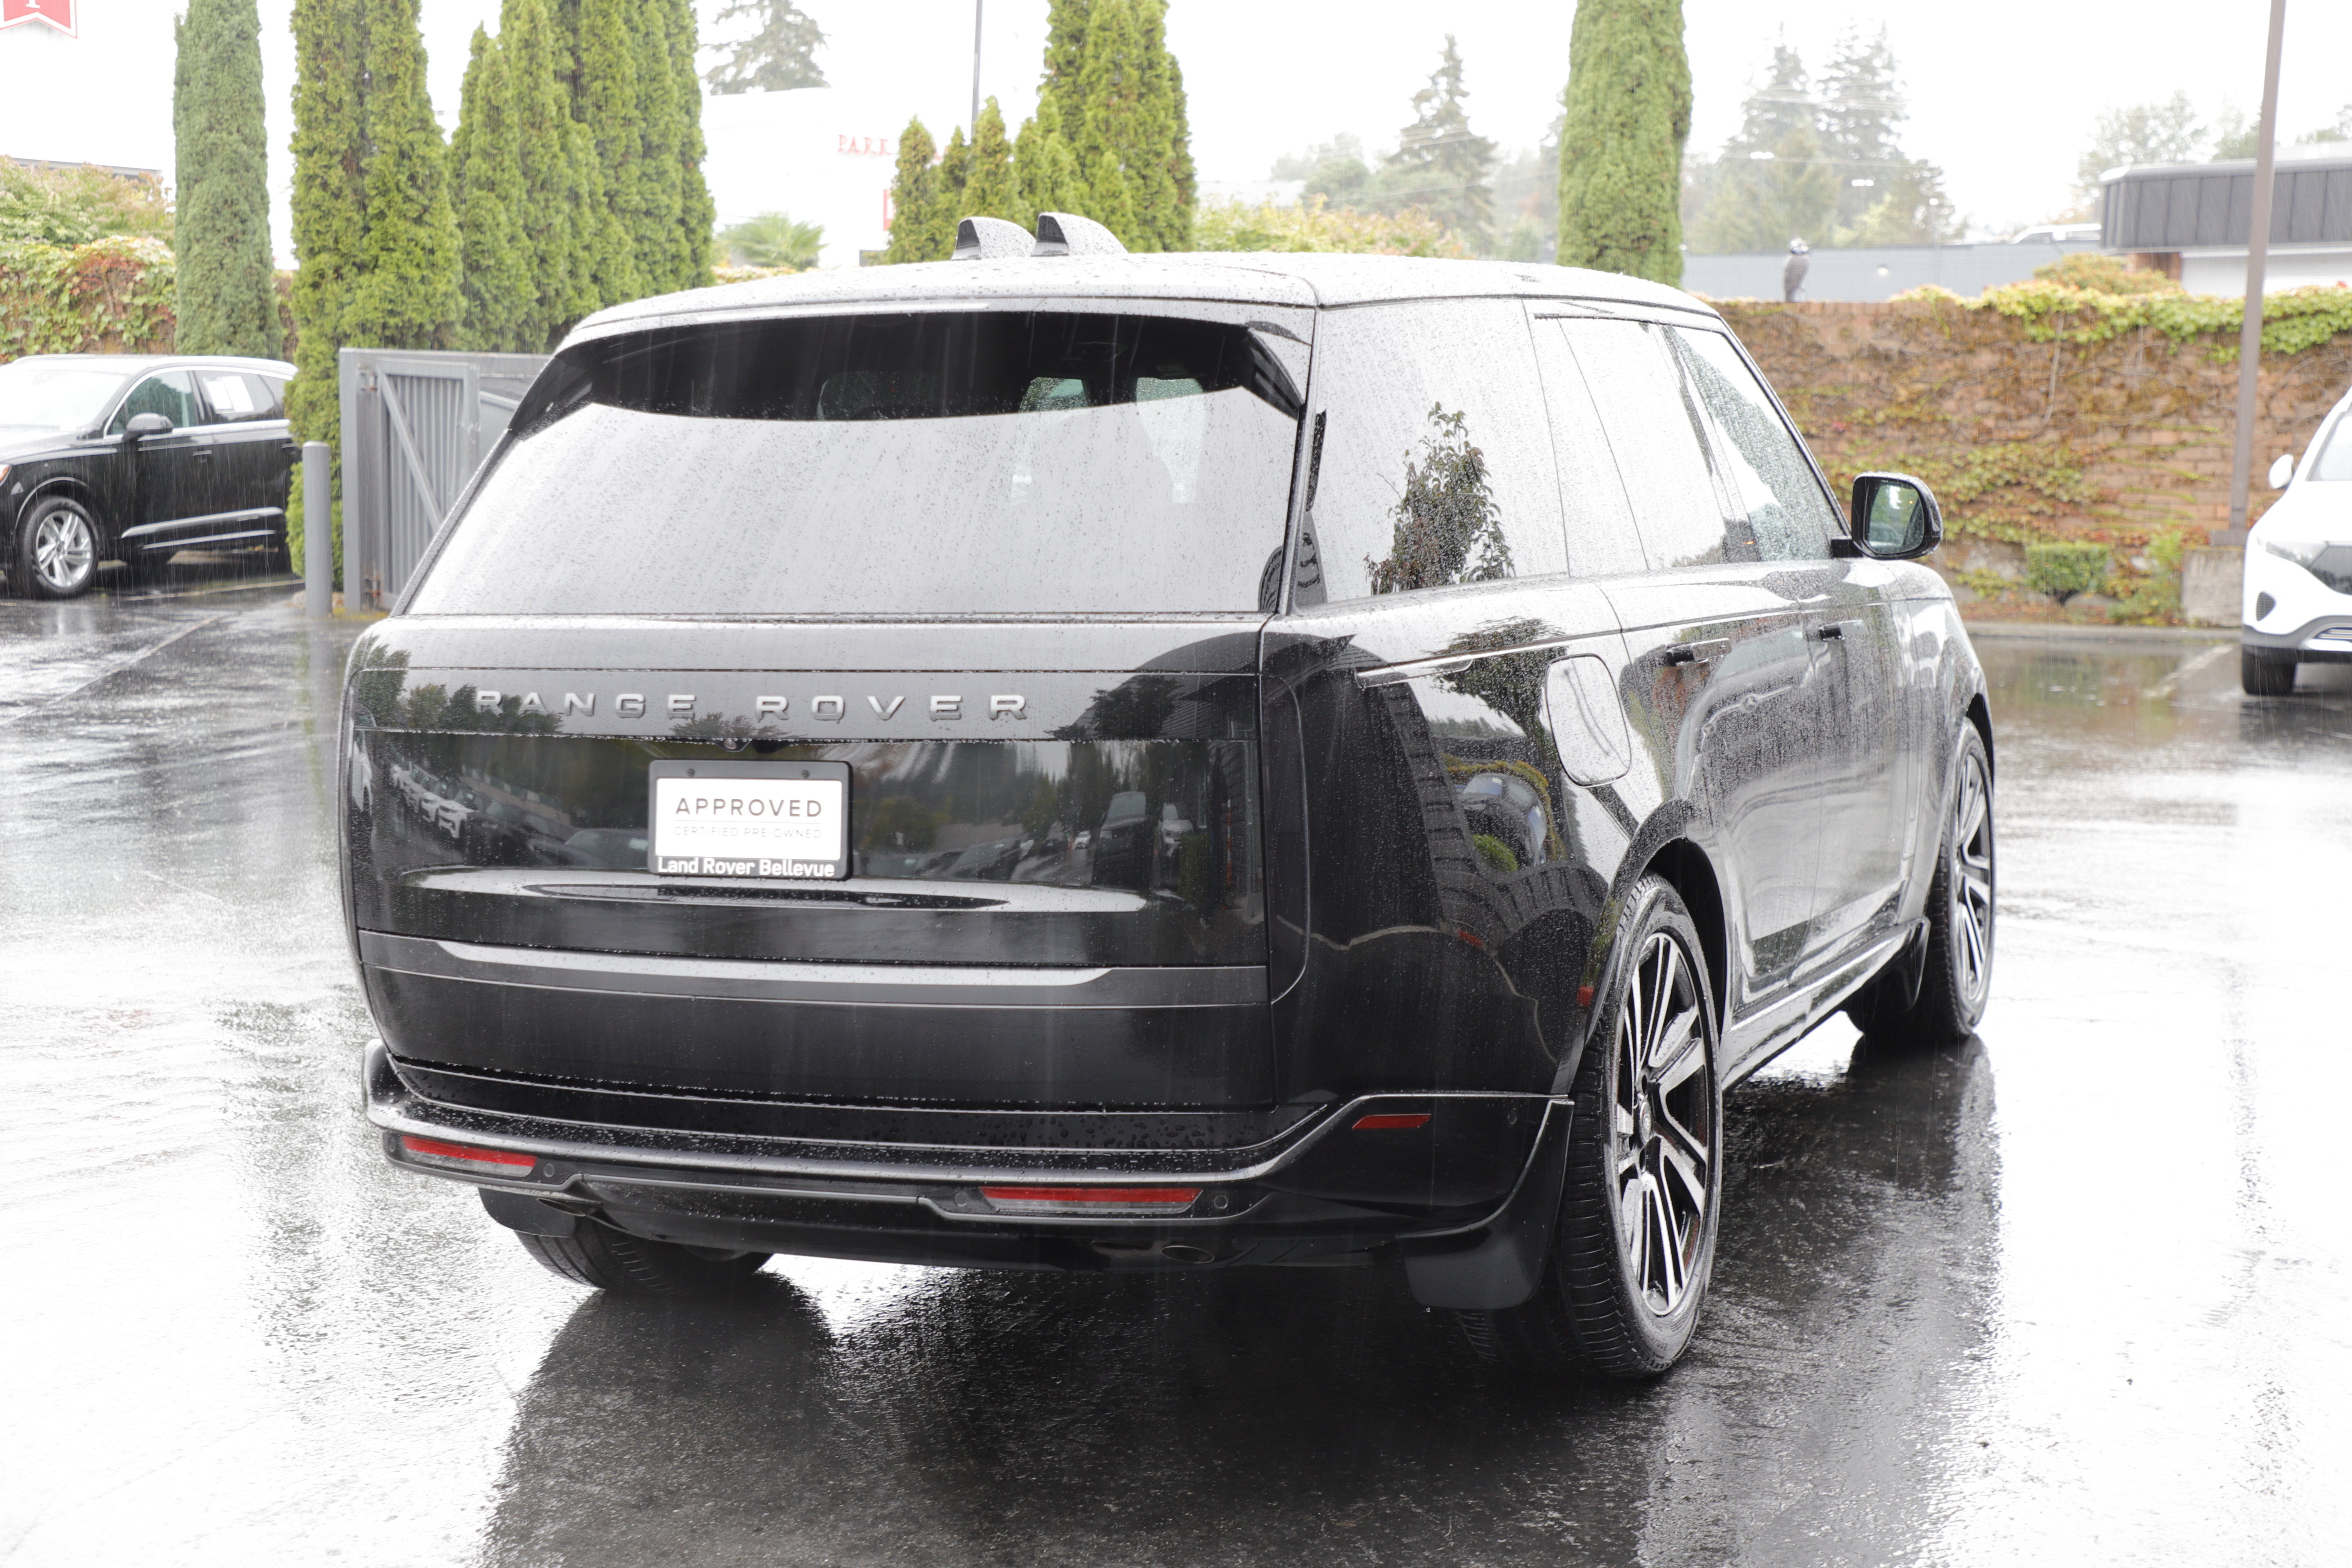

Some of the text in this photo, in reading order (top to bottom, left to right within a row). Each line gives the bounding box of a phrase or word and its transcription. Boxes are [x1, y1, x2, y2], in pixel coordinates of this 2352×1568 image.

[837, 134, 892, 156] PARK
[477, 690, 1027, 722] RANGE ROVER
[675, 797, 822, 817] APPROVED
[674, 826, 822, 838] CERTIFIED PRE-OWNED
[658, 857, 835, 877] Land Rover Bellevue
